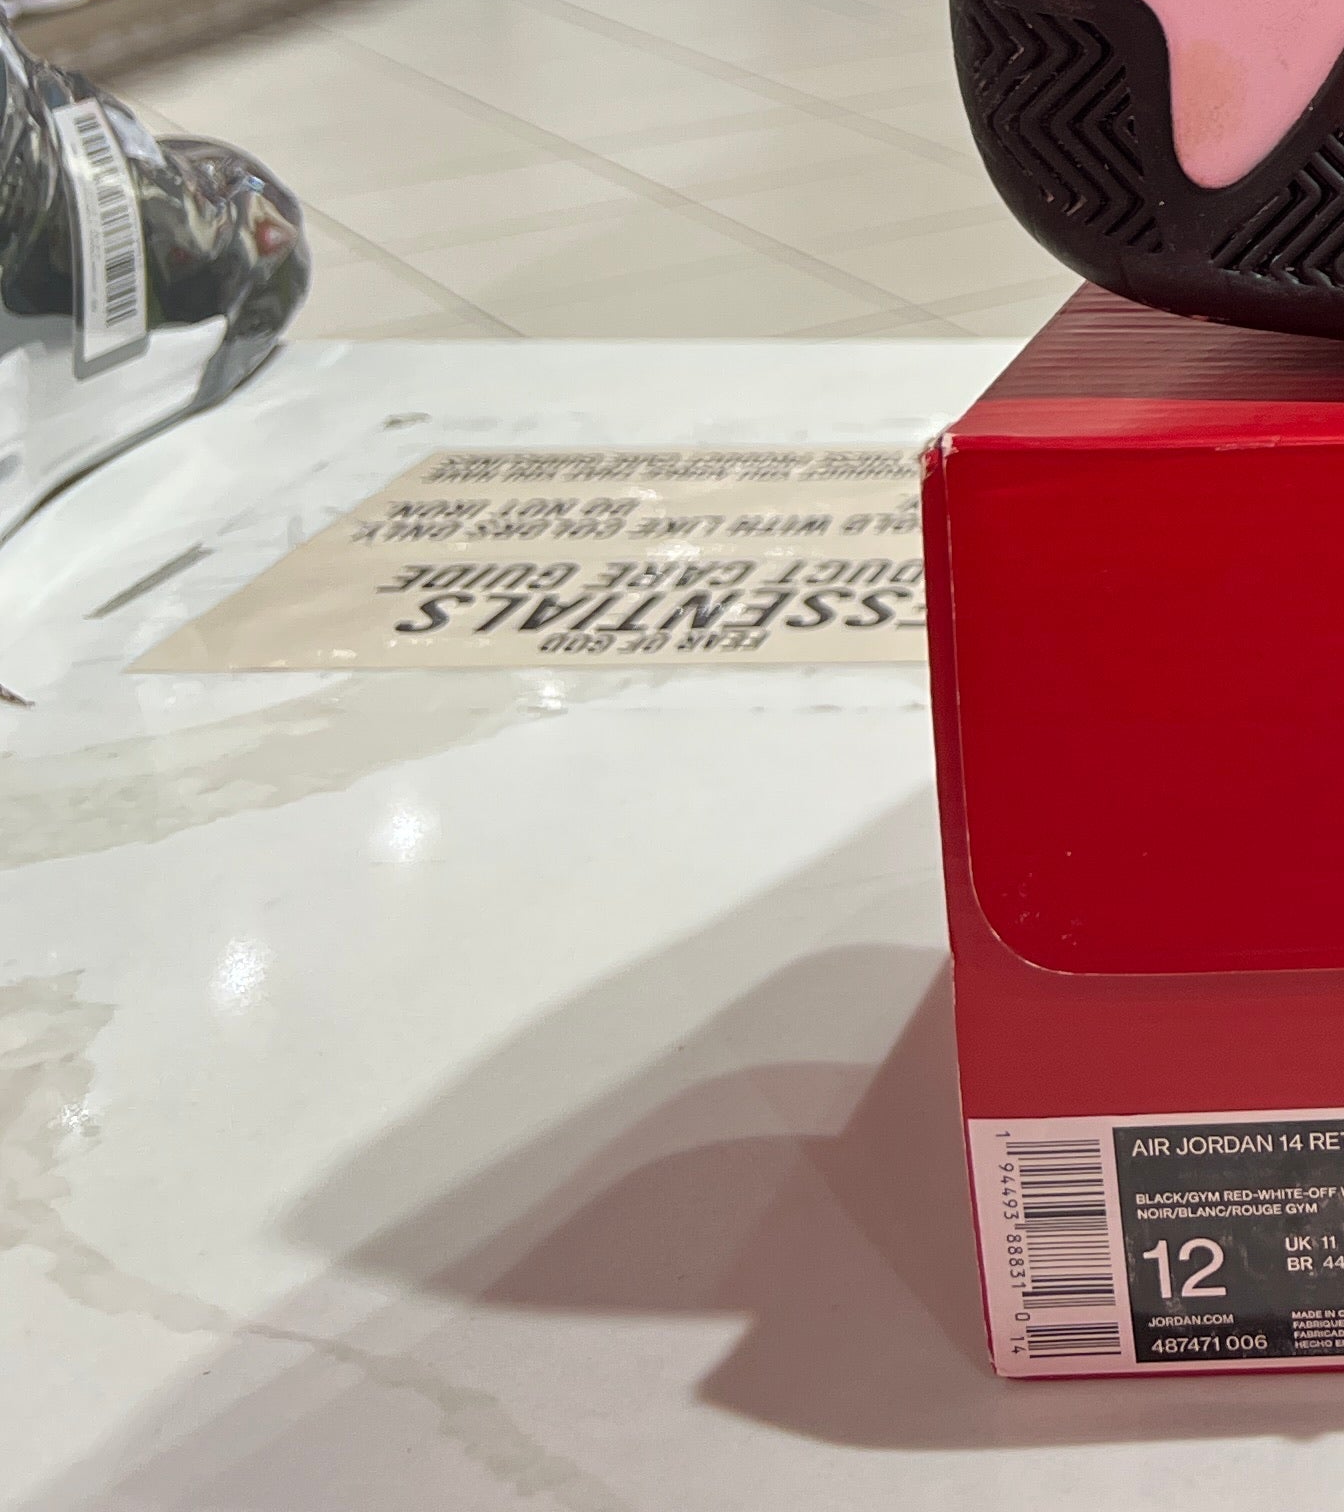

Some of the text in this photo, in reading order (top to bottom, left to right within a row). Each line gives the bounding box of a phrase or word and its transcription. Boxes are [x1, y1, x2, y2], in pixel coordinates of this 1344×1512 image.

[464, 517, 627, 540] COLORS
[625, 515, 726, 538] LIKE
[724, 514, 832, 537] WITH
[376, 561, 579, 593] GUIDE
[582, 559, 756, 590] CARE
[538, 628, 769, 654] FEAR OF GOD
[1132, 1137, 1170, 1157] AIR
[1176, 1134, 1273, 1156] JORDAN
[1279, 1134, 1303, 1151] 14
[999, 1163, 1019, 1220] 94493
[1135, 1191, 1220, 1205] BLACK/GYM
[1224, 1187, 1336, 1202] RED-WHITE-OFF
[1137, 1203, 1317, 1220] NOIR/BLANC/ROUGE GYM
[1285, 1235, 1336, 1251] UK 11
[1006, 1234, 1027, 1290] 88831
[1143, 1237, 1227, 1299] 12
[1287, 1256, 1313, 1272] BR
[1148, 1313, 1234, 1328] JORDAN.COM
[1291, 1310, 1322, 1319] MADE
[1325, 1310, 1335, 1318] IN
[1293, 1319, 1344, 1329] FABRIQUE
[1151, 1334, 1268, 1353] 487471 006
[1295, 1339, 1333, 1348] HECHO
